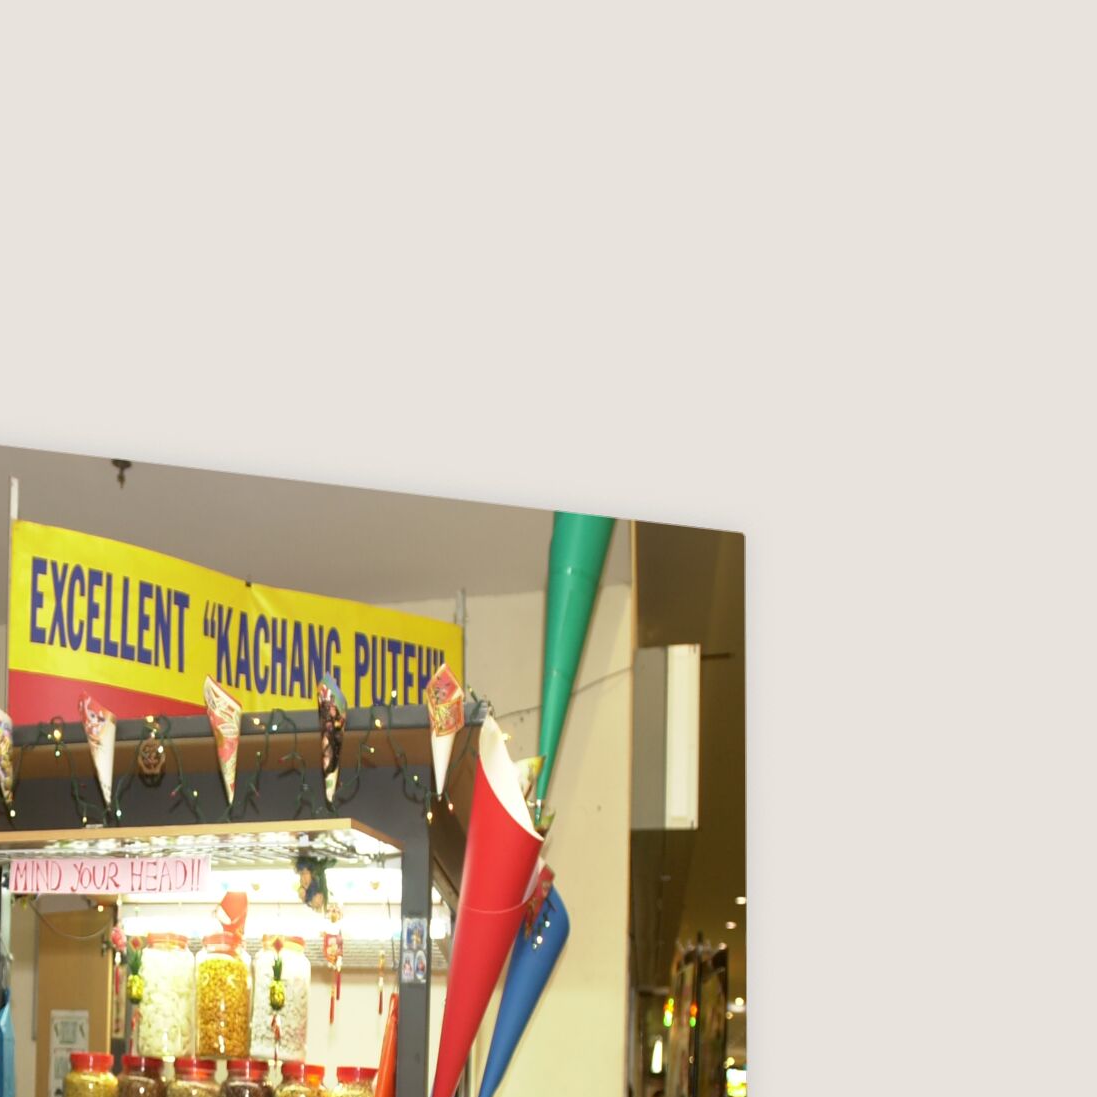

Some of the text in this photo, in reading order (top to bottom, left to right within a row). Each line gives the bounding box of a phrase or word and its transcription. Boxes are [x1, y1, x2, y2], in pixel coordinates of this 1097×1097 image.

[29, 555, 190, 673] EXCELLENT
[13, 858, 202, 892] MIND YOUR HEAD!!
